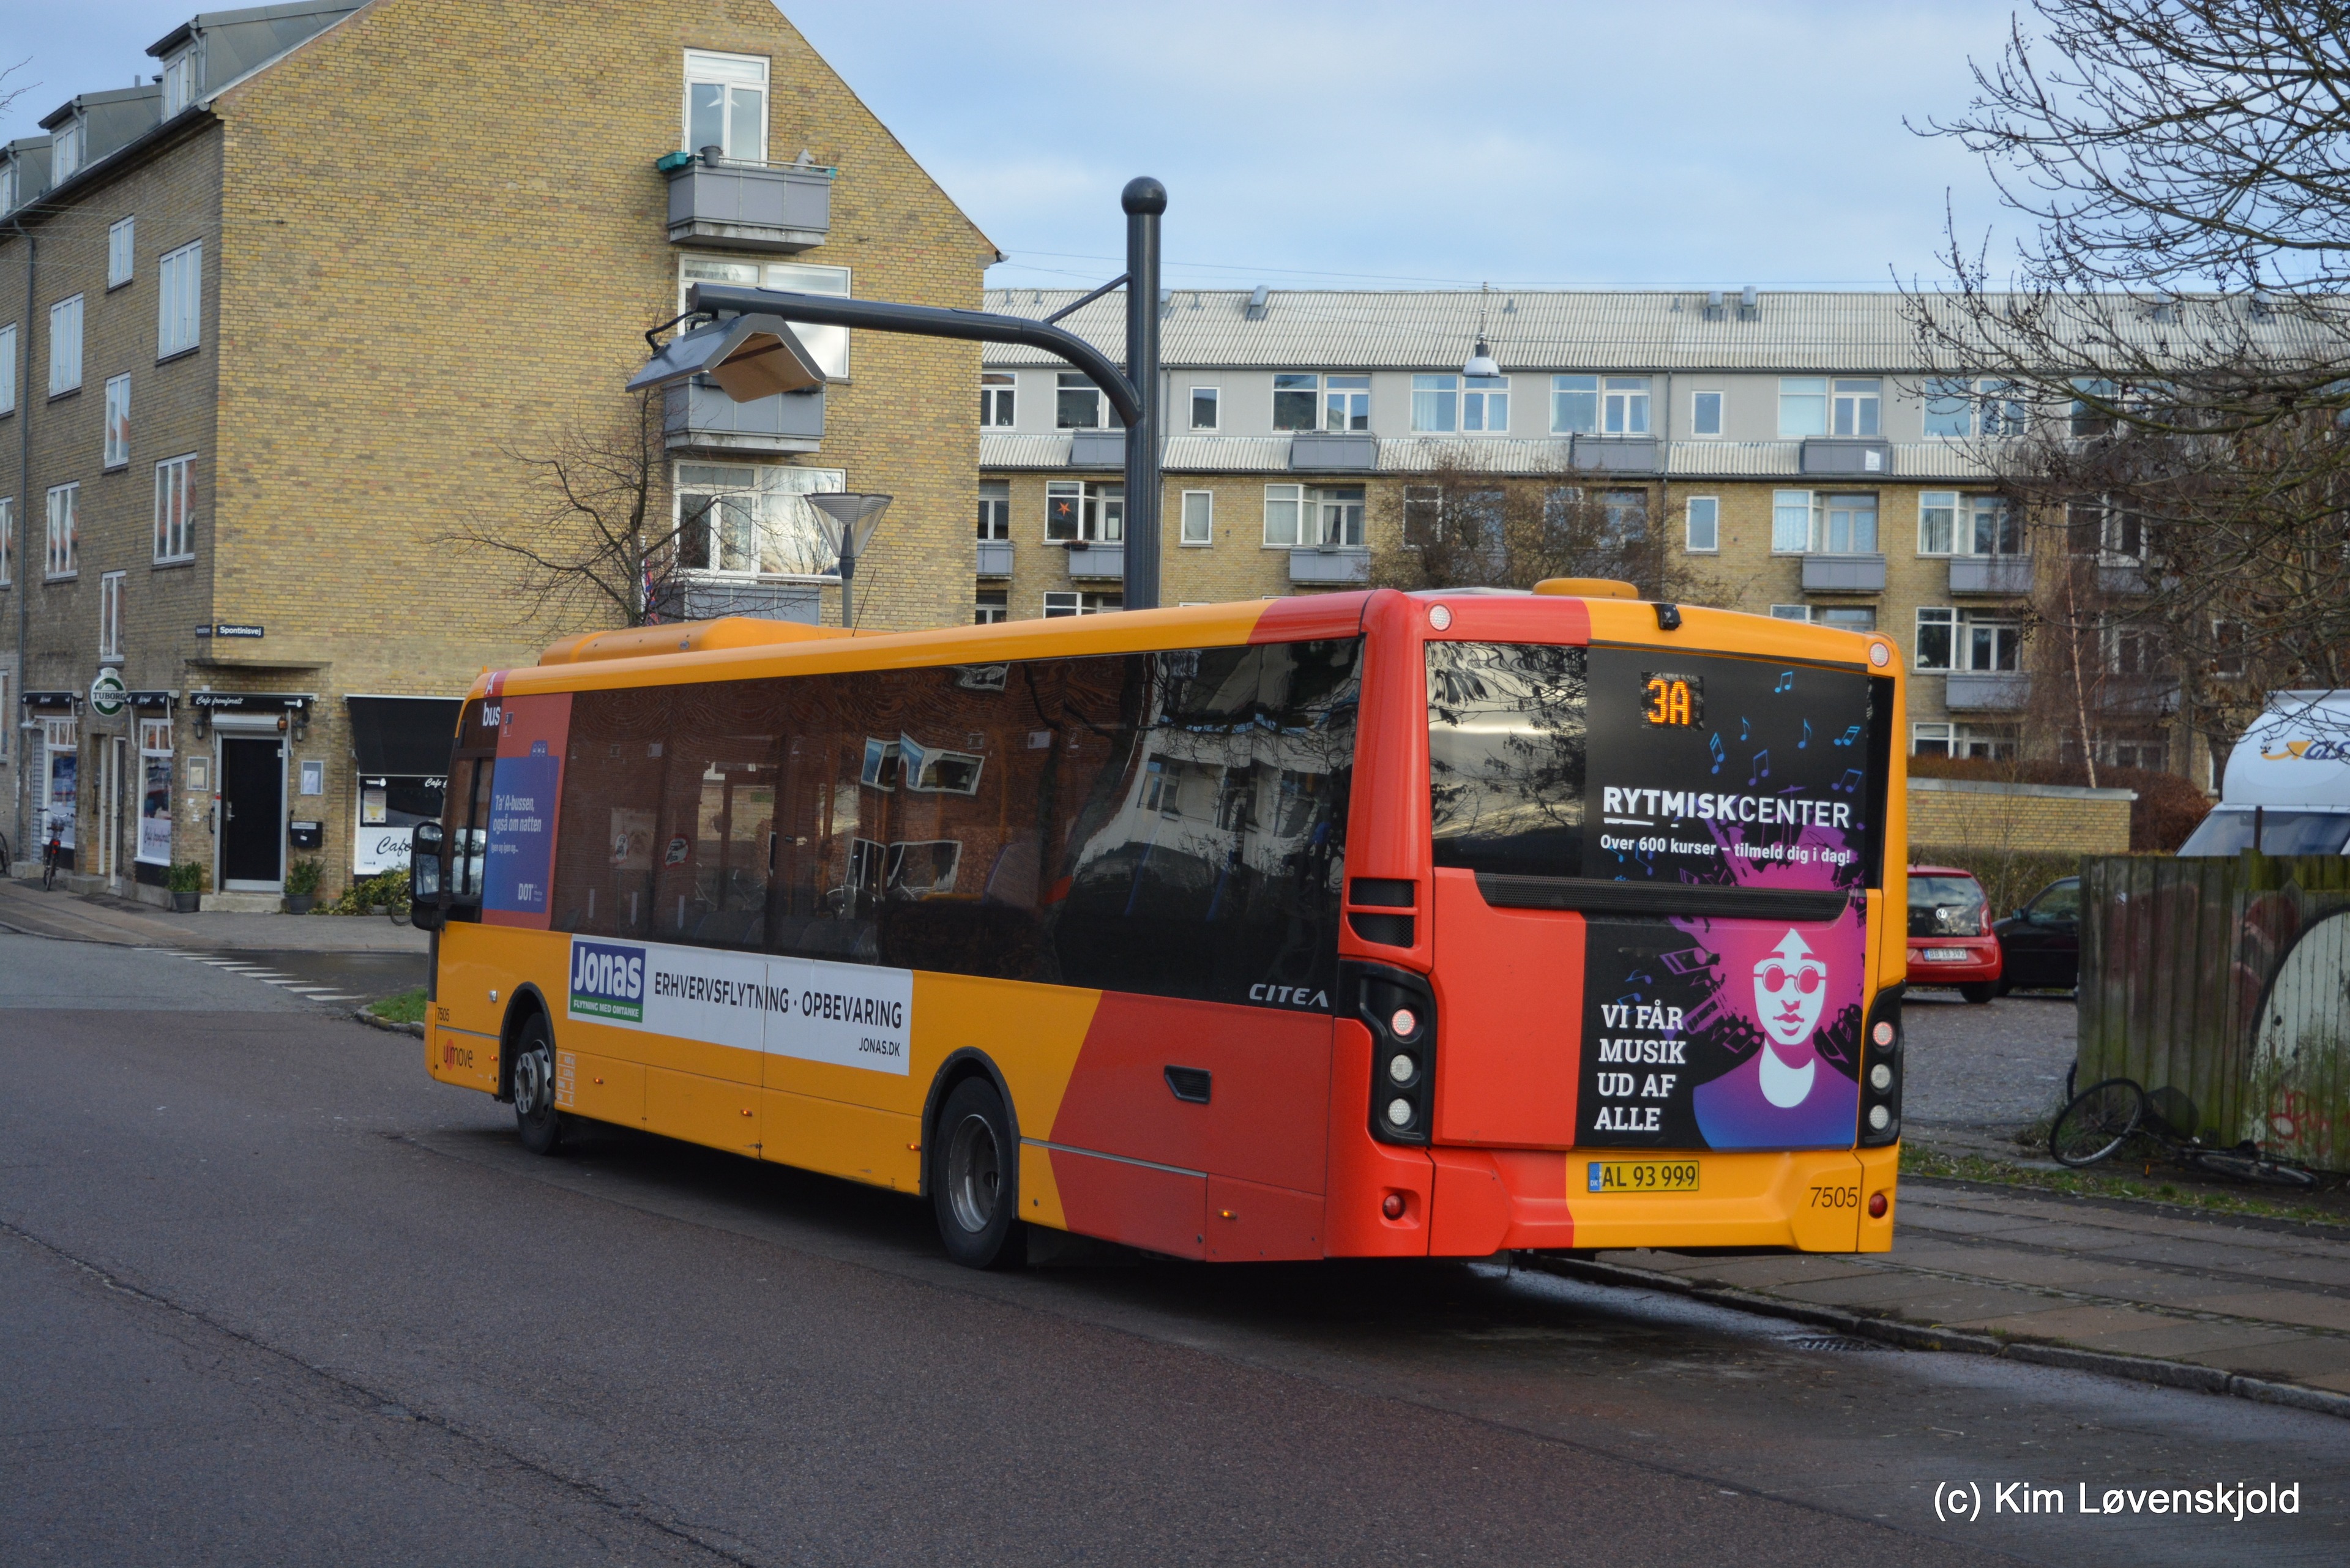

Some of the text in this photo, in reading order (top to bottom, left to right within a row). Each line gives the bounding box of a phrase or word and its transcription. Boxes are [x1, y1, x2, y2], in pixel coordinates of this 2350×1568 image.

[220, 626, 261, 636] Spontinisvej
[485, 672, 498, 695] A
[92, 692, 125, 700] TUBORG
[1647, 679, 1690, 725] 3A
[482, 702, 501, 726] bus
[505, 794, 534, 813] A-bussen,
[1603, 786, 1849, 828] RYTMISKCENTER
[493, 813, 542, 835] også om natten
[1600, 834, 1635, 850] Over
[1639, 837, 1665, 853] 600
[1671, 838, 1716, 855] kurser
[1734, 842, 1783, 859] tilmeld
[1786, 846, 1808, 864] dig
[1813, 848, 1817, 861] i
[1821, 848, 1851, 867] dag!
[518, 883, 534, 901] DOT
[574, 947, 641, 999] Jonas
[655, 972, 789, 1014] ERHVERVSFLYTNING
[802, 990, 902, 1029] OPBEVARING
[1249, 983, 1329, 1007] CITEA
[437, 1007, 450, 1021] 7505
[573, 999, 639, 1018] FLYTNING MED OMTANKE
[1601, 999, 1684, 1031] VI FÅR
[859, 1037, 901, 1057] JONAS.DK
[1598, 1038, 1686, 1064] MUSIK
[1597, 1072, 1676, 1097] UD AF
[1594, 1107, 1660, 1131] ALLE
[1602, 1166, 1627, 1187] AL
[1633, 1165, 1655, 1187] 93
[1661, 1165, 1696, 1187] 999
[1810, 1187, 1858, 1208] 7505
